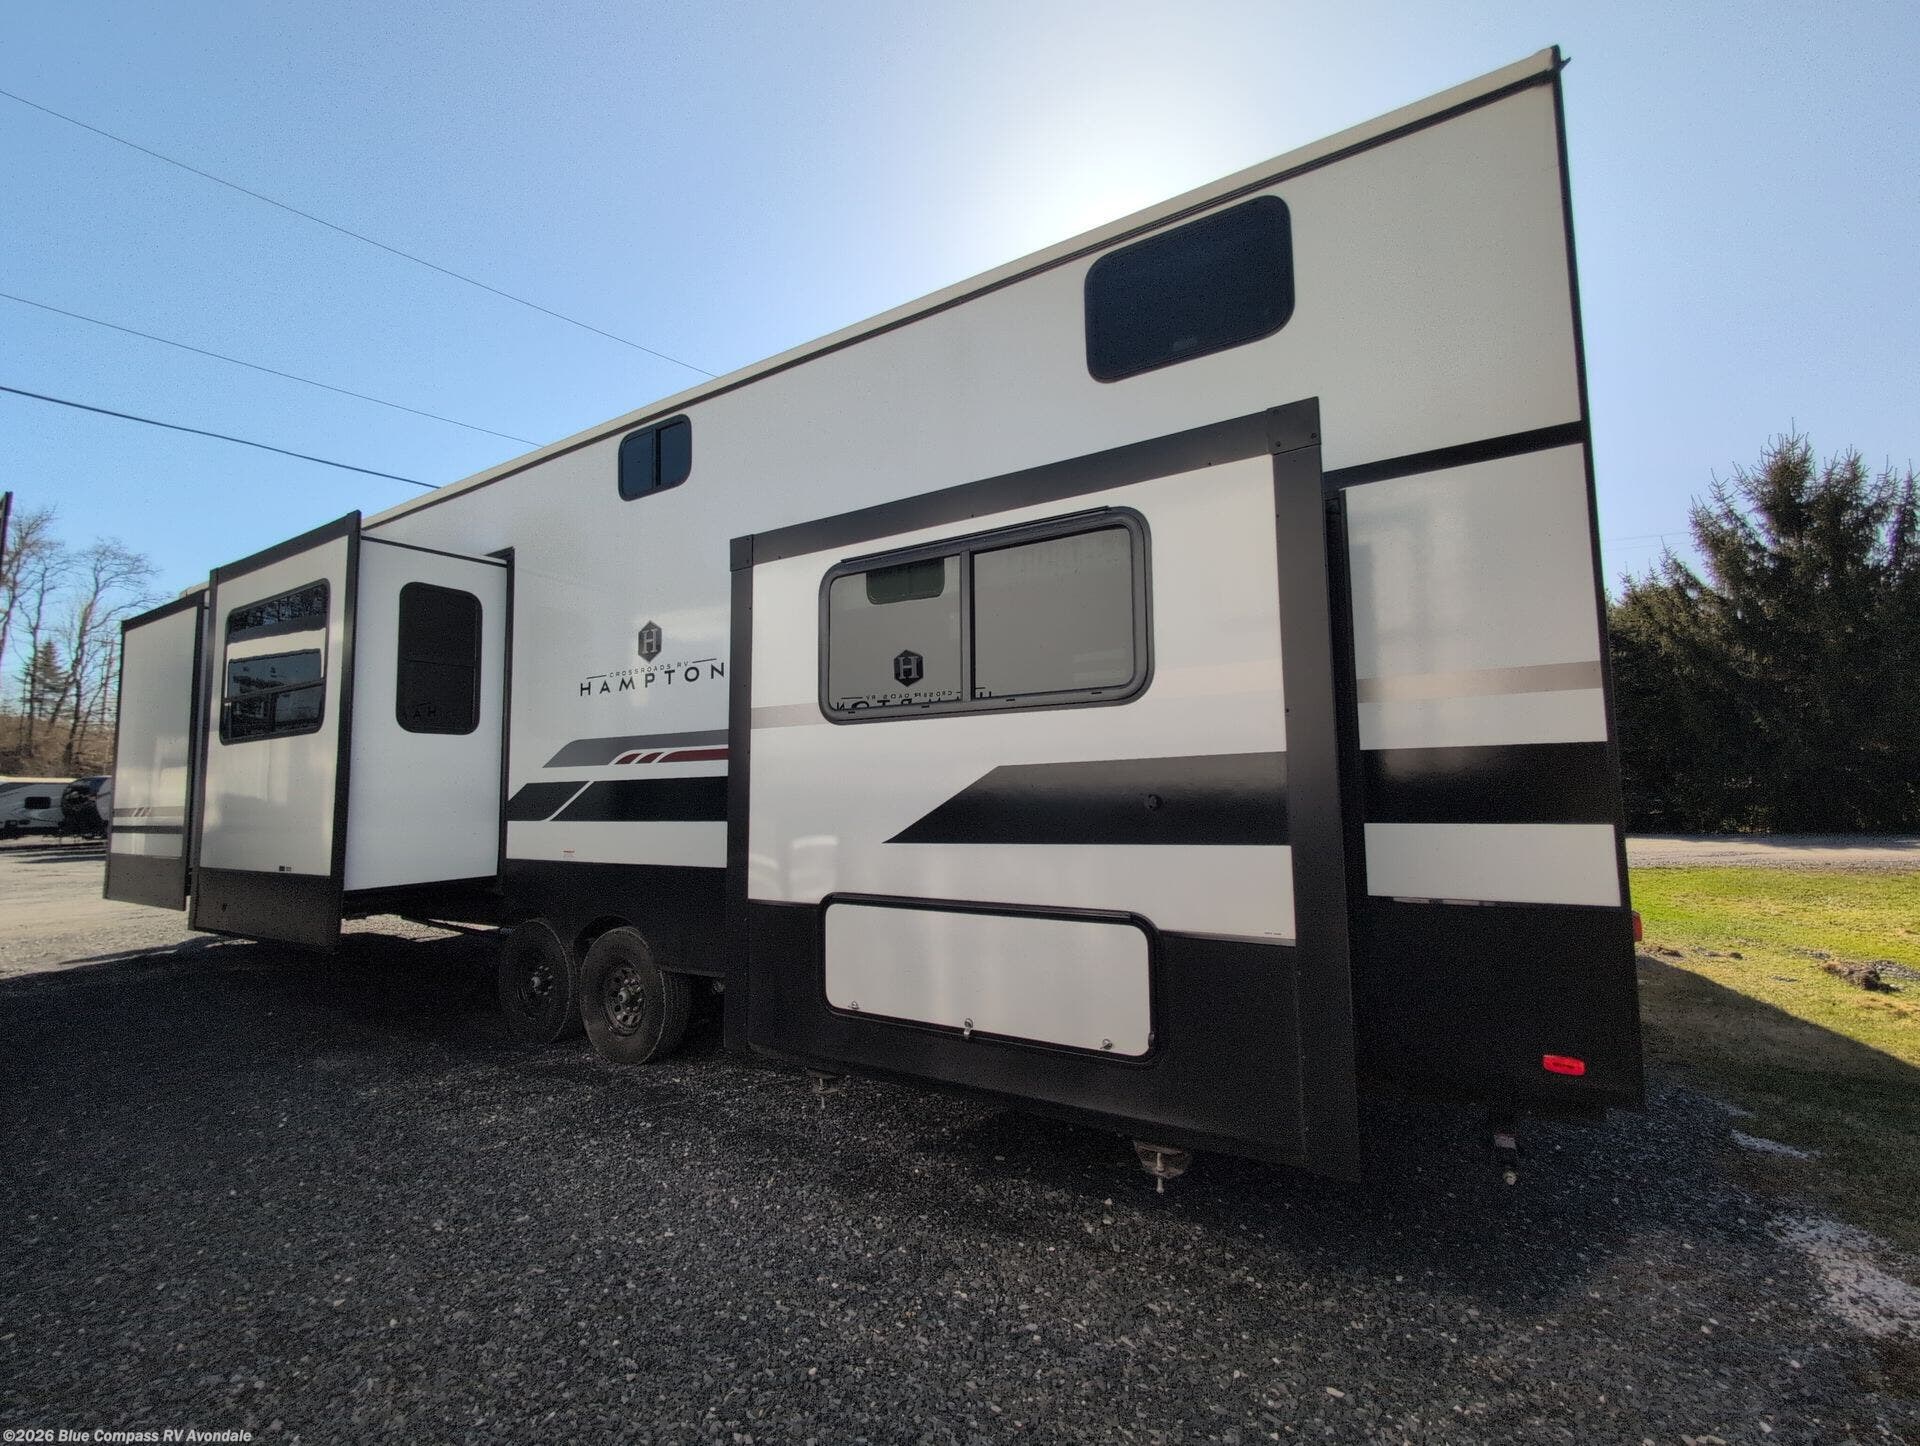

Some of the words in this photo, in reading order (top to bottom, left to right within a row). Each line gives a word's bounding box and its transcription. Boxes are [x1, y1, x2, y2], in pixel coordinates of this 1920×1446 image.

[580, 662, 726, 697] HAMPTON
[609, 663, 672, 678] CROSSROADS
[676, 660, 689, 668] RV
